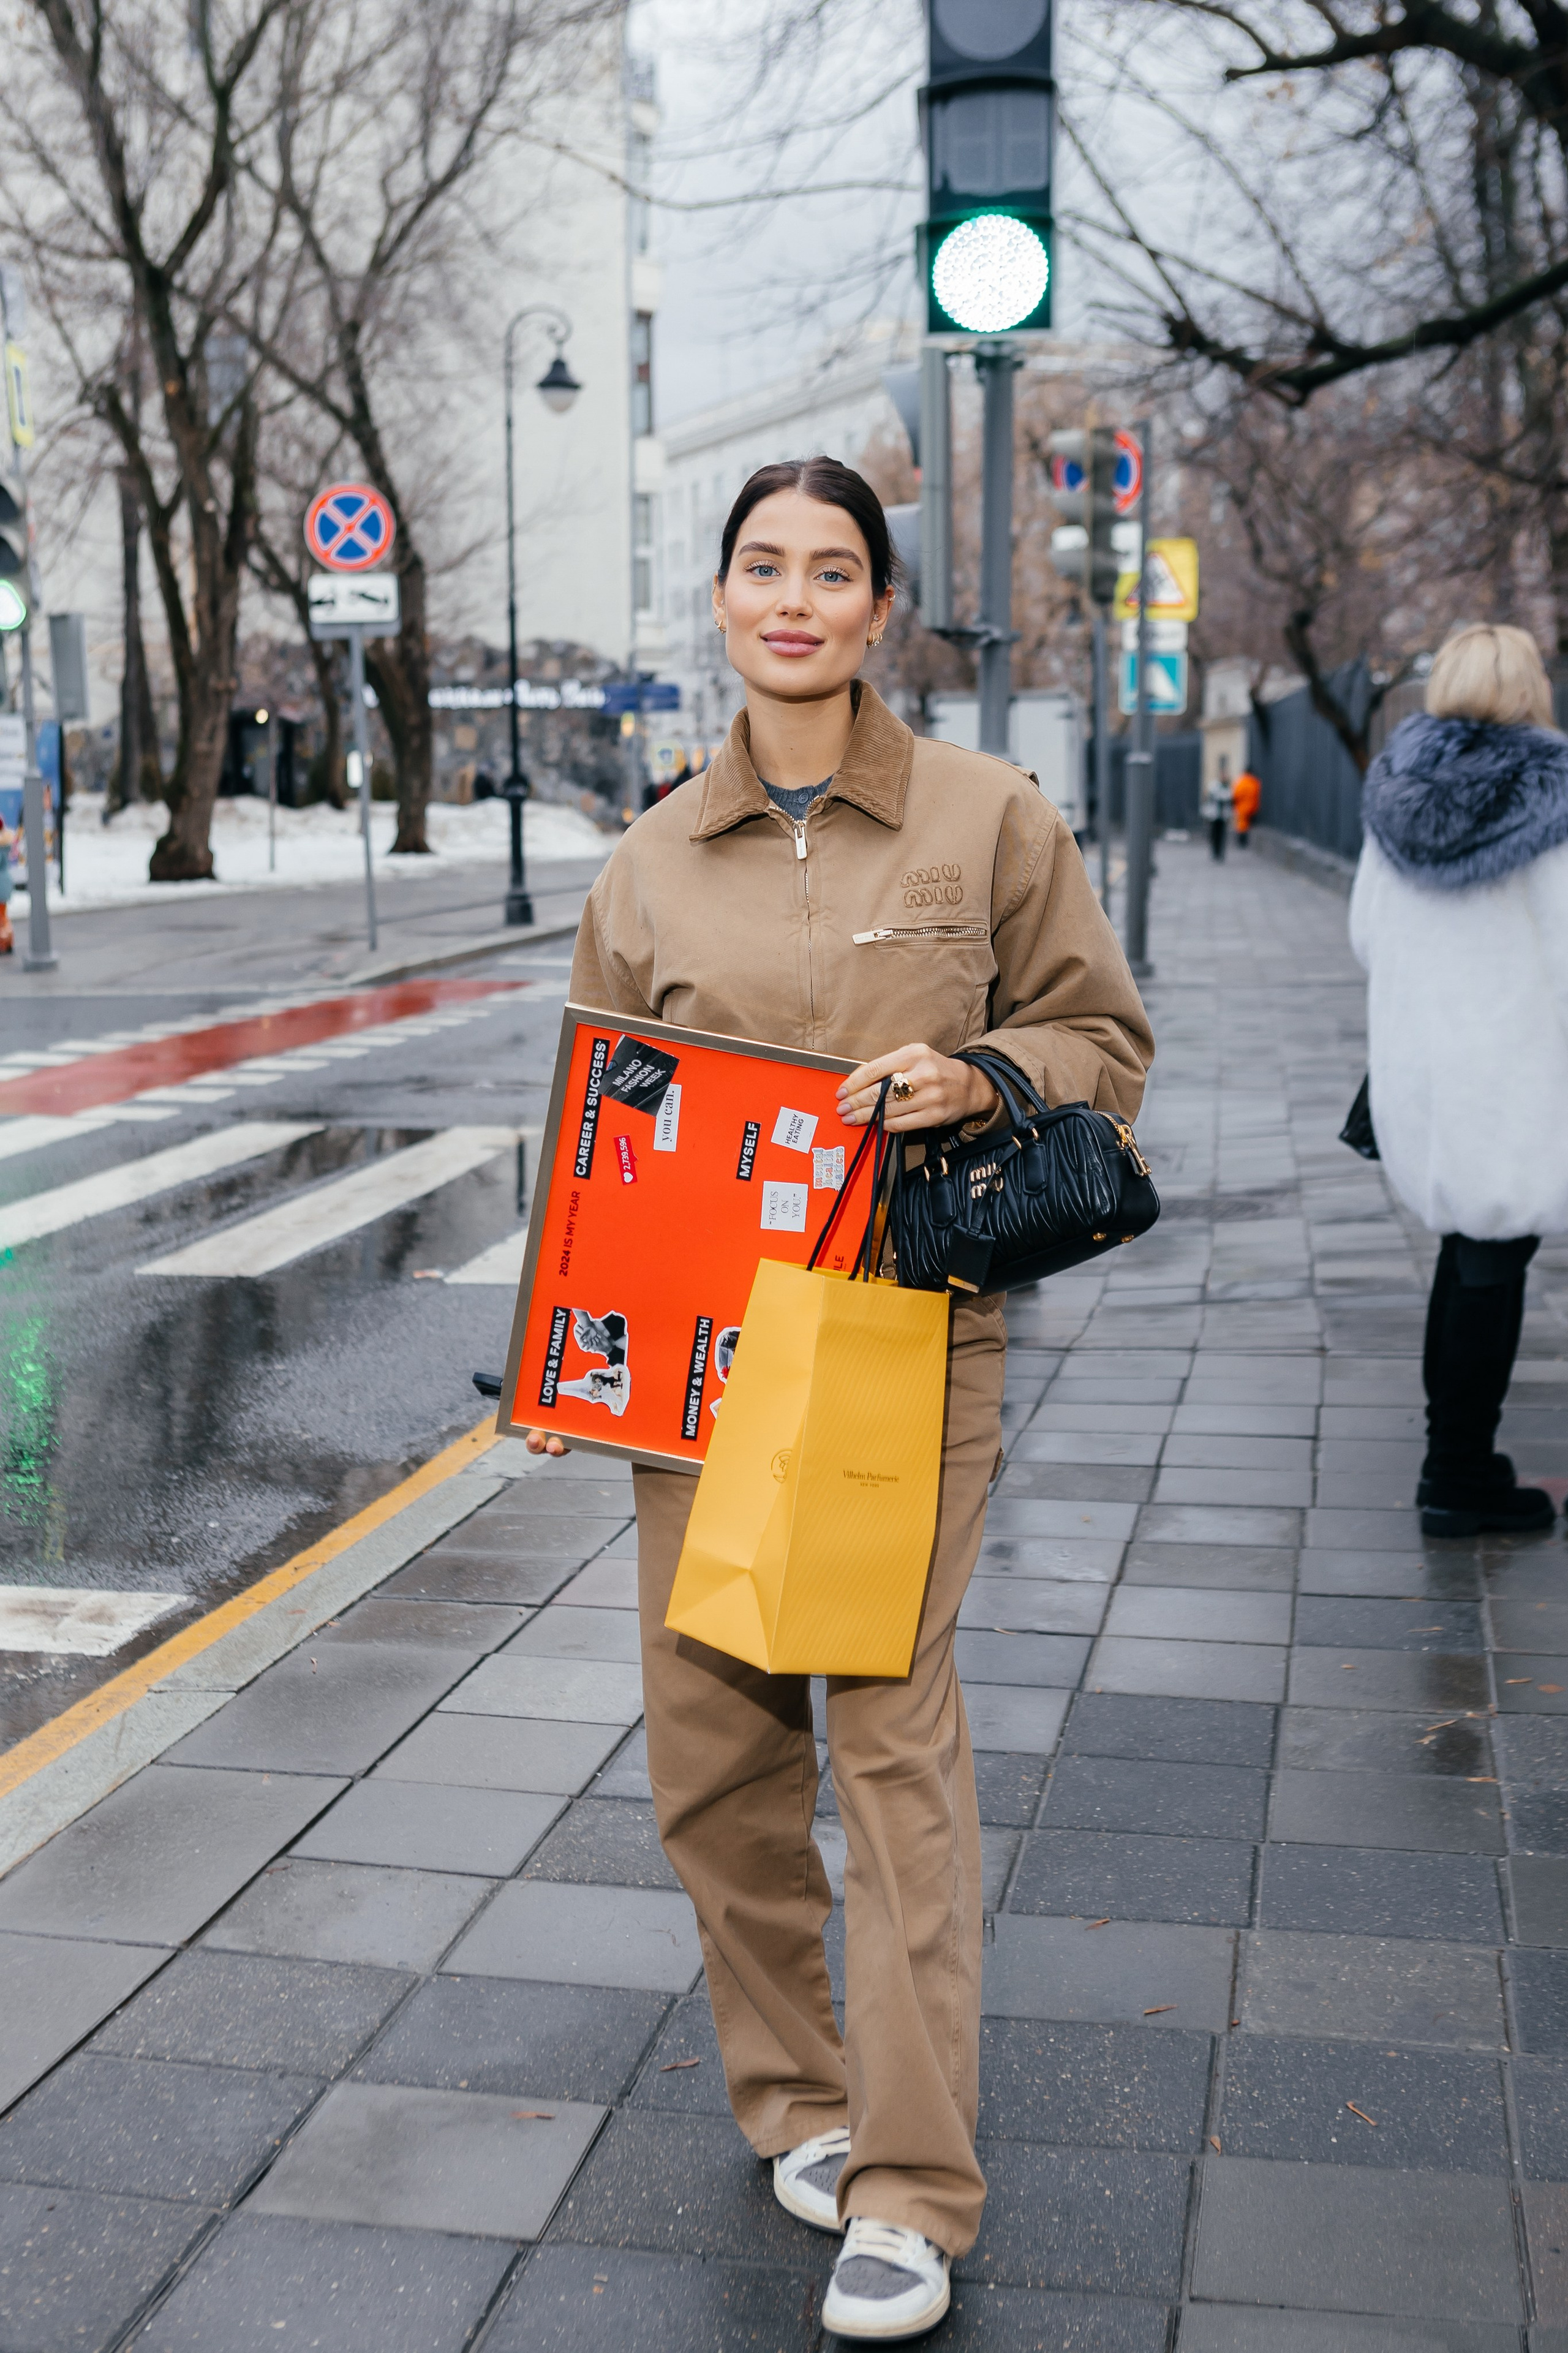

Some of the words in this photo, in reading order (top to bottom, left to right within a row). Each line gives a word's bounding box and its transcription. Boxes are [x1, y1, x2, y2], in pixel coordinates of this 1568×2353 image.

[612, 1059, 642, 1087] MILANO
[621, 1065, 655, 1093] FASHION
[639, 1069, 666, 1087] WEEK
[665, 1090, 675, 1115] can.
[576, 1121, 594, 1176] CAREER
[585, 1109, 595, 1119] &
[662, 1119, 672, 1142] you
[785, 1114, 798, 1144] HEALTHY
[792, 1119, 804, 1144] EATING
[619, 1137, 631, 1170] 2,739,596
[739, 1122, 758, 1177] MYSELF
[813, 1149, 823, 1187] mental
[823, 1150, 834, 1185] health
[568, 1191, 581, 1217] YEAR
[781, 1199, 789, 1214] ON
[565, 1220, 575, 1236] MY
[564, 1238, 573, 1248] IS
[559, 1250, 571, 1277] 2024
[550, 1309, 566, 1356] FAMILY
[694, 1319, 710, 1373] WEALTH
[548, 1359, 558, 1369] &
[541, 1370, 556, 1403] LOVE
[692, 1377, 703, 1386] &
[685, 1388, 701, 1437] MONEY
